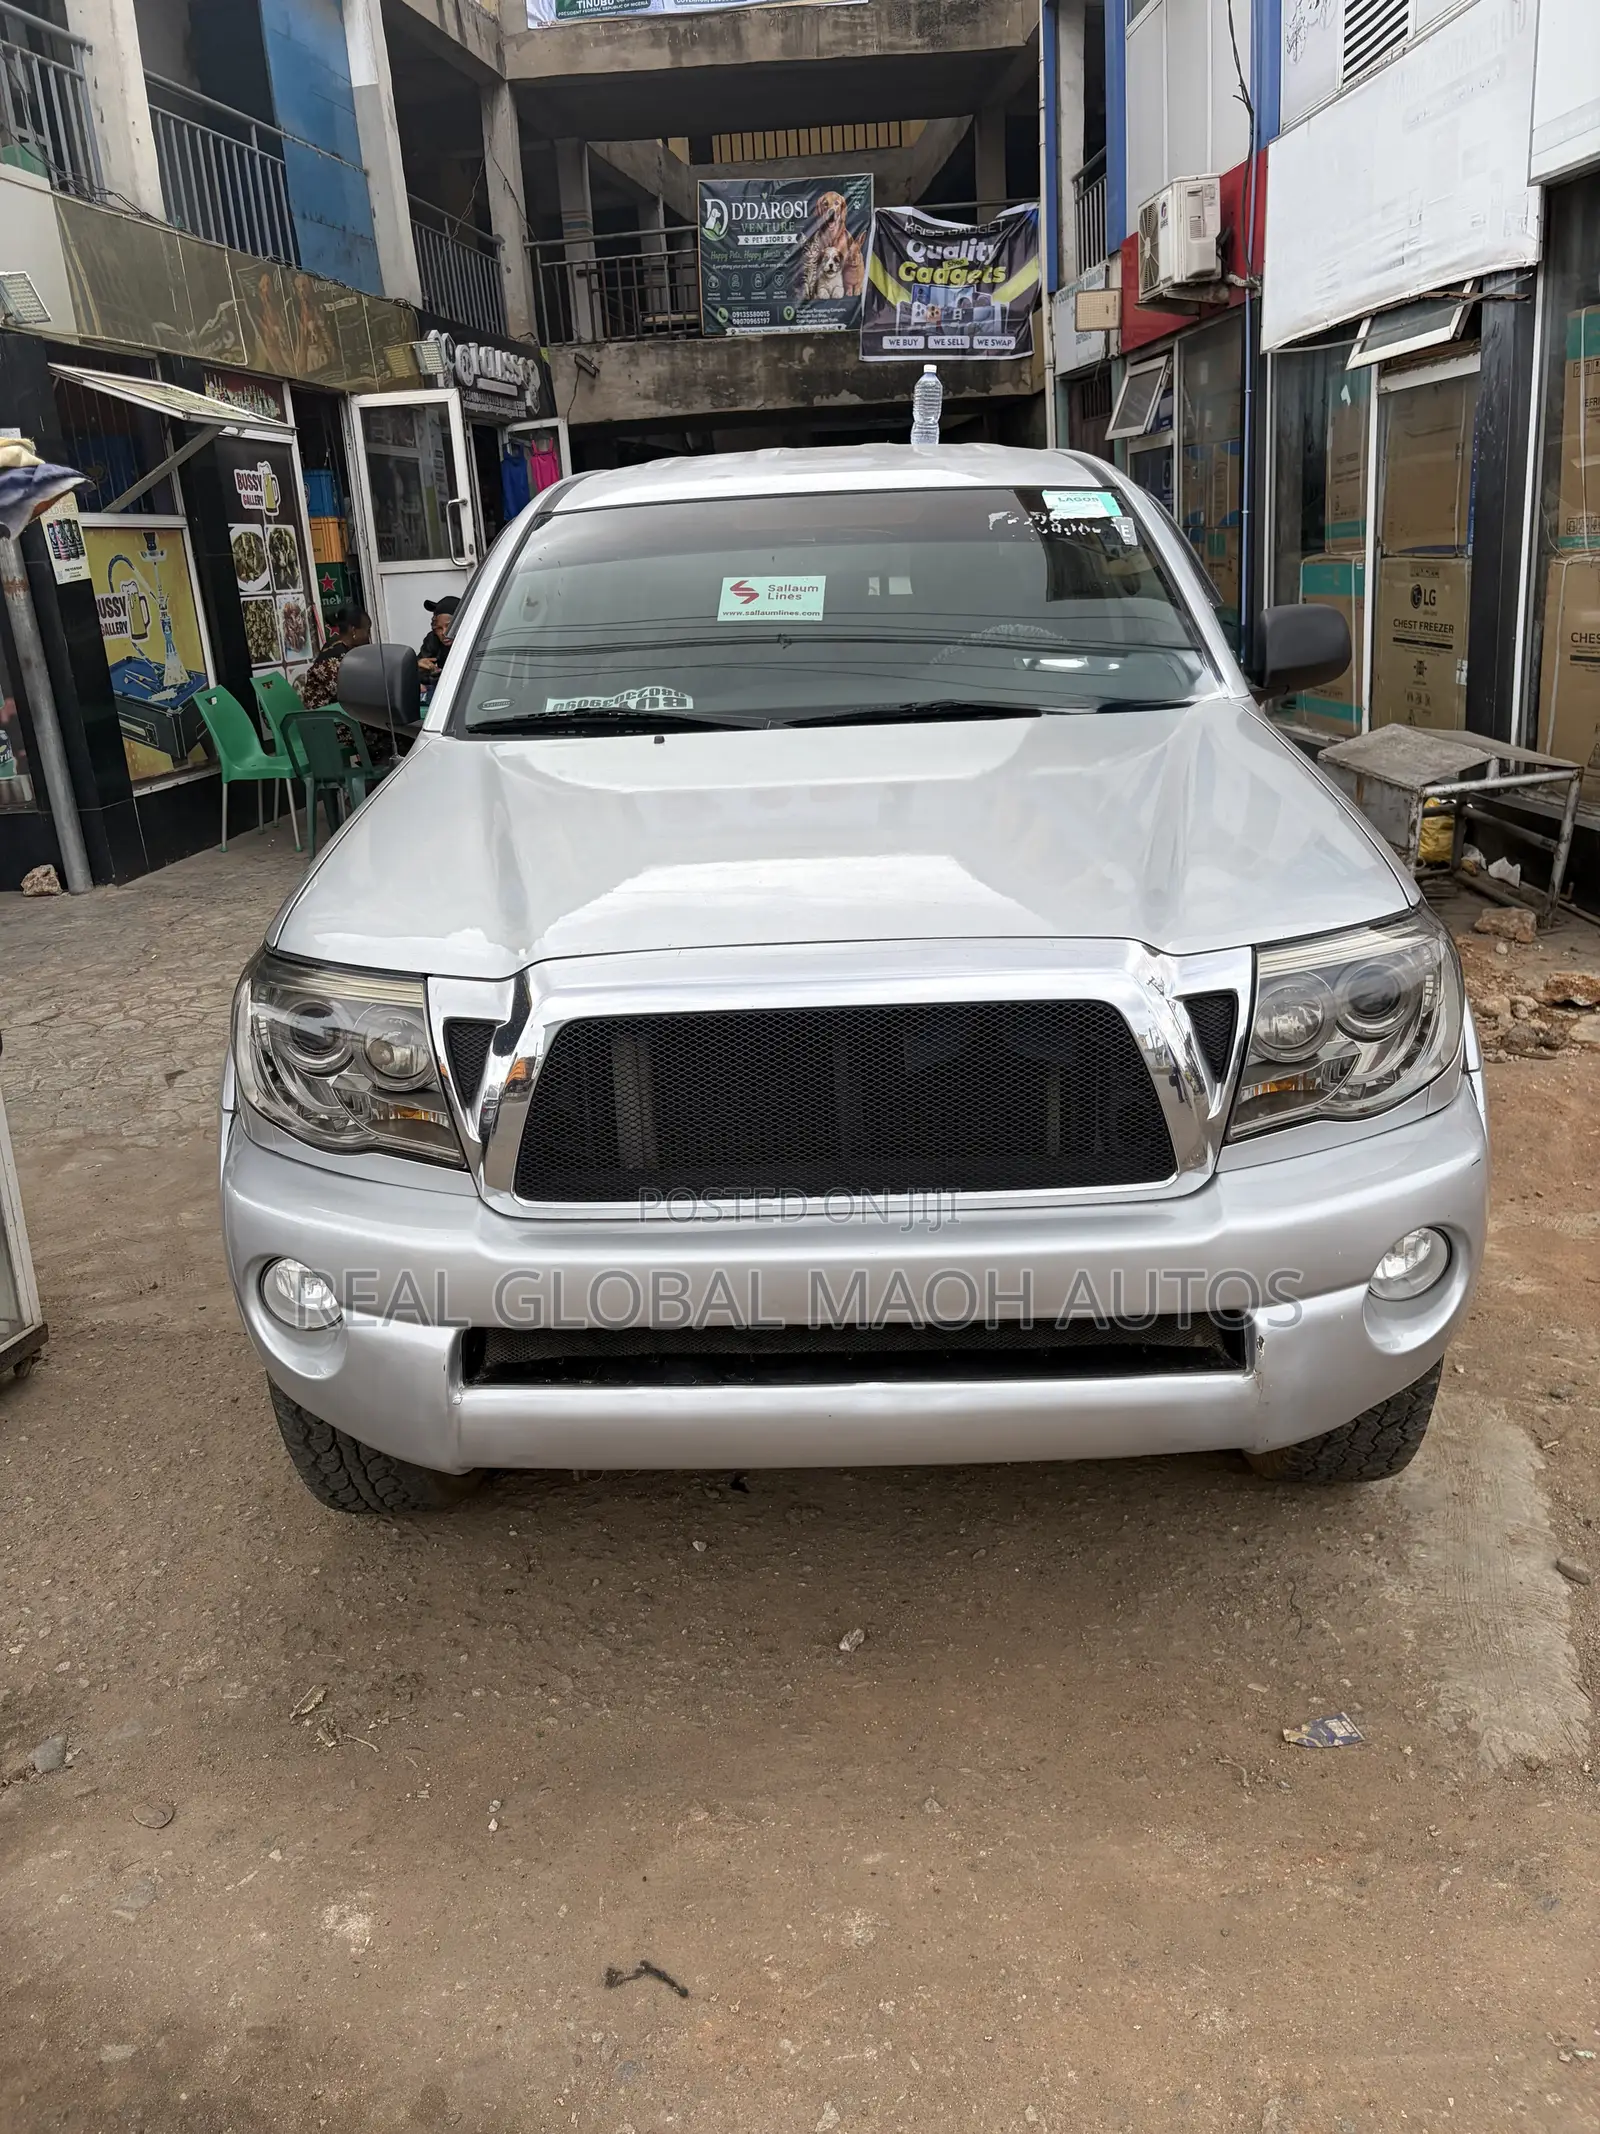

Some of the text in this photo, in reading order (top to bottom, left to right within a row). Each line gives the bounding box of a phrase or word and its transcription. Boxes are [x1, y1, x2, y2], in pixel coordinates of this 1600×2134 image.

[577, 0, 614, 9] TINUBU
[731, 200, 808, 221] D'DAROSI
[741, 222, 795, 233] VENTURE
[765, 235, 784, 243] STORE
[906, 238, 1000, 266] Quality
[899, 261, 1007, 287] Gadgets
[934, 338, 965, 346] WE SELL
[977, 338, 1012, 346] WE SWAP
[236, 472, 263, 492] BUSSY
[243, 494, 264, 506] GALLERY
[768, 584, 819, 593] Sallaum
[768, 592, 803, 601] Lines
[1423, 588, 1436, 606] LG
[97, 595, 127, 619] USSY
[722, 609, 820, 617] www.sallaumlines.com
[100, 620, 128, 637] GALLERY
[1393, 618, 1454, 634] CHEST FREEZER
[1570, 632, 1600, 644] CHES
